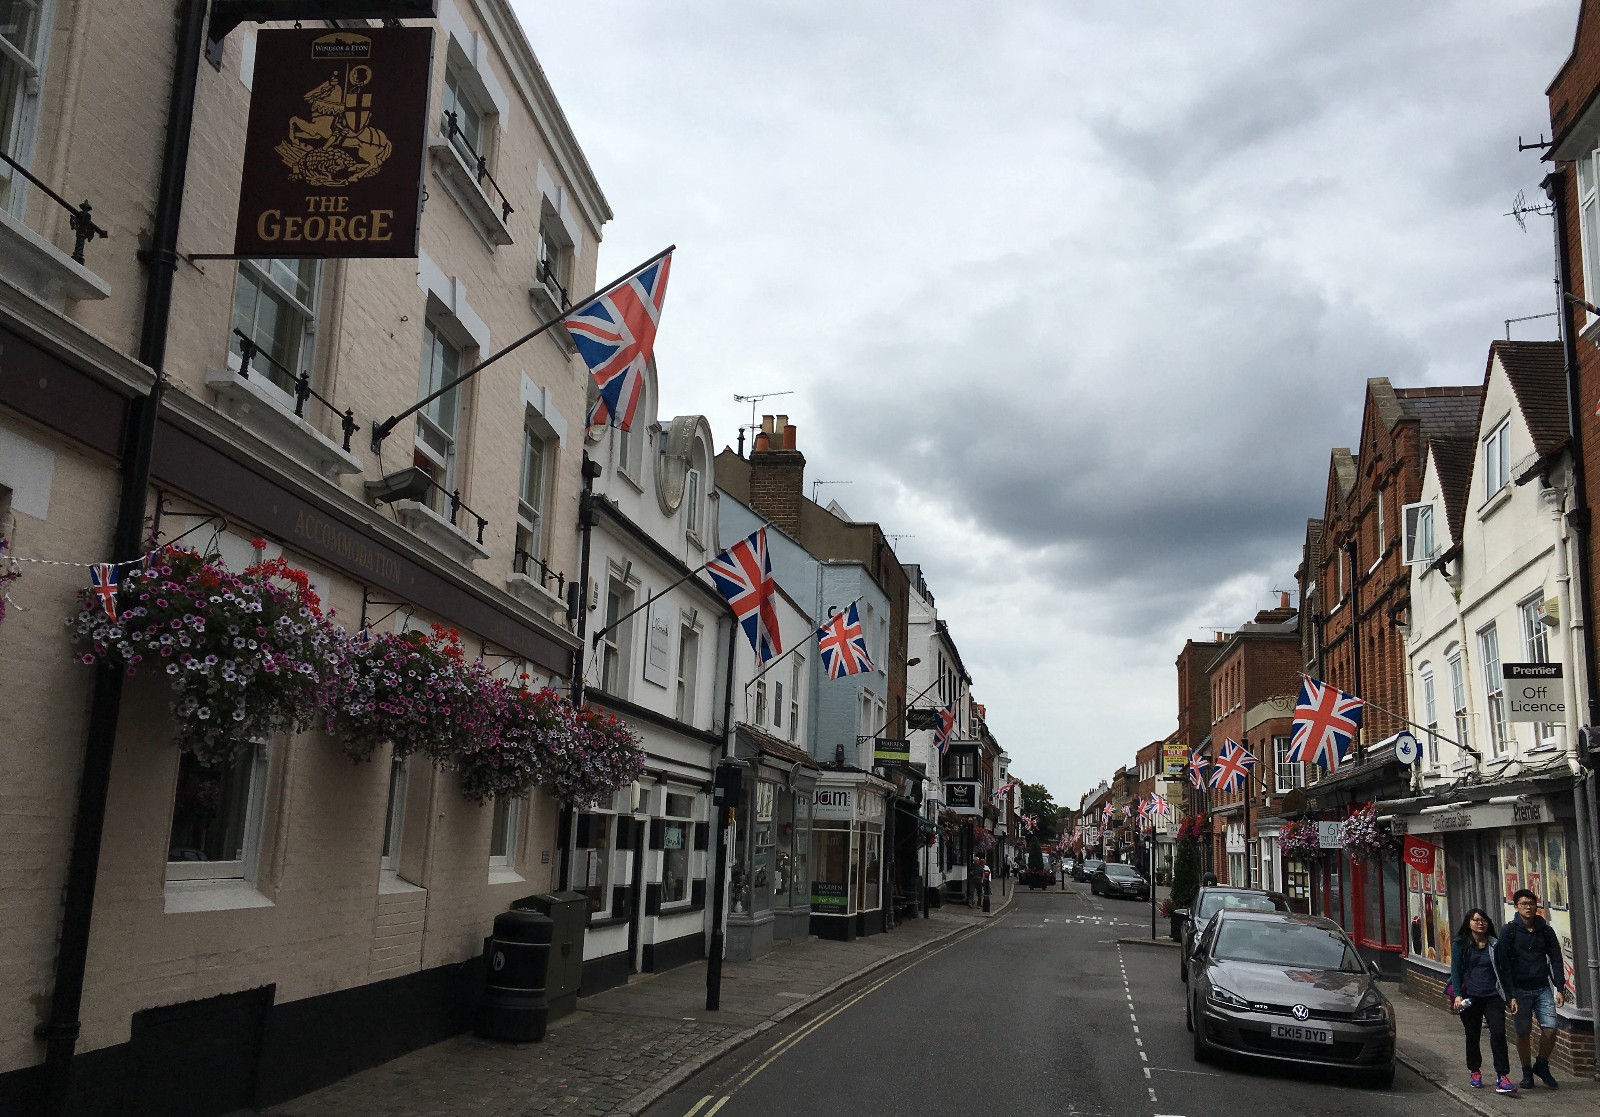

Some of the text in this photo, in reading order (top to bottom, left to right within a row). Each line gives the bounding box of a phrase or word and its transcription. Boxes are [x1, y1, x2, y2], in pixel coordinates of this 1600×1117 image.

[305, 196, 349, 212] THE
[257, 209, 394, 241] GEORGE
[294, 509, 400, 583] ACCOMMODATION
[1512, 666, 1557, 675] Premier
[1522, 686, 1548, 700] Off
[1510, 700, 1566, 712] Licence
[1277, 1026, 1303, 1039] CK15
